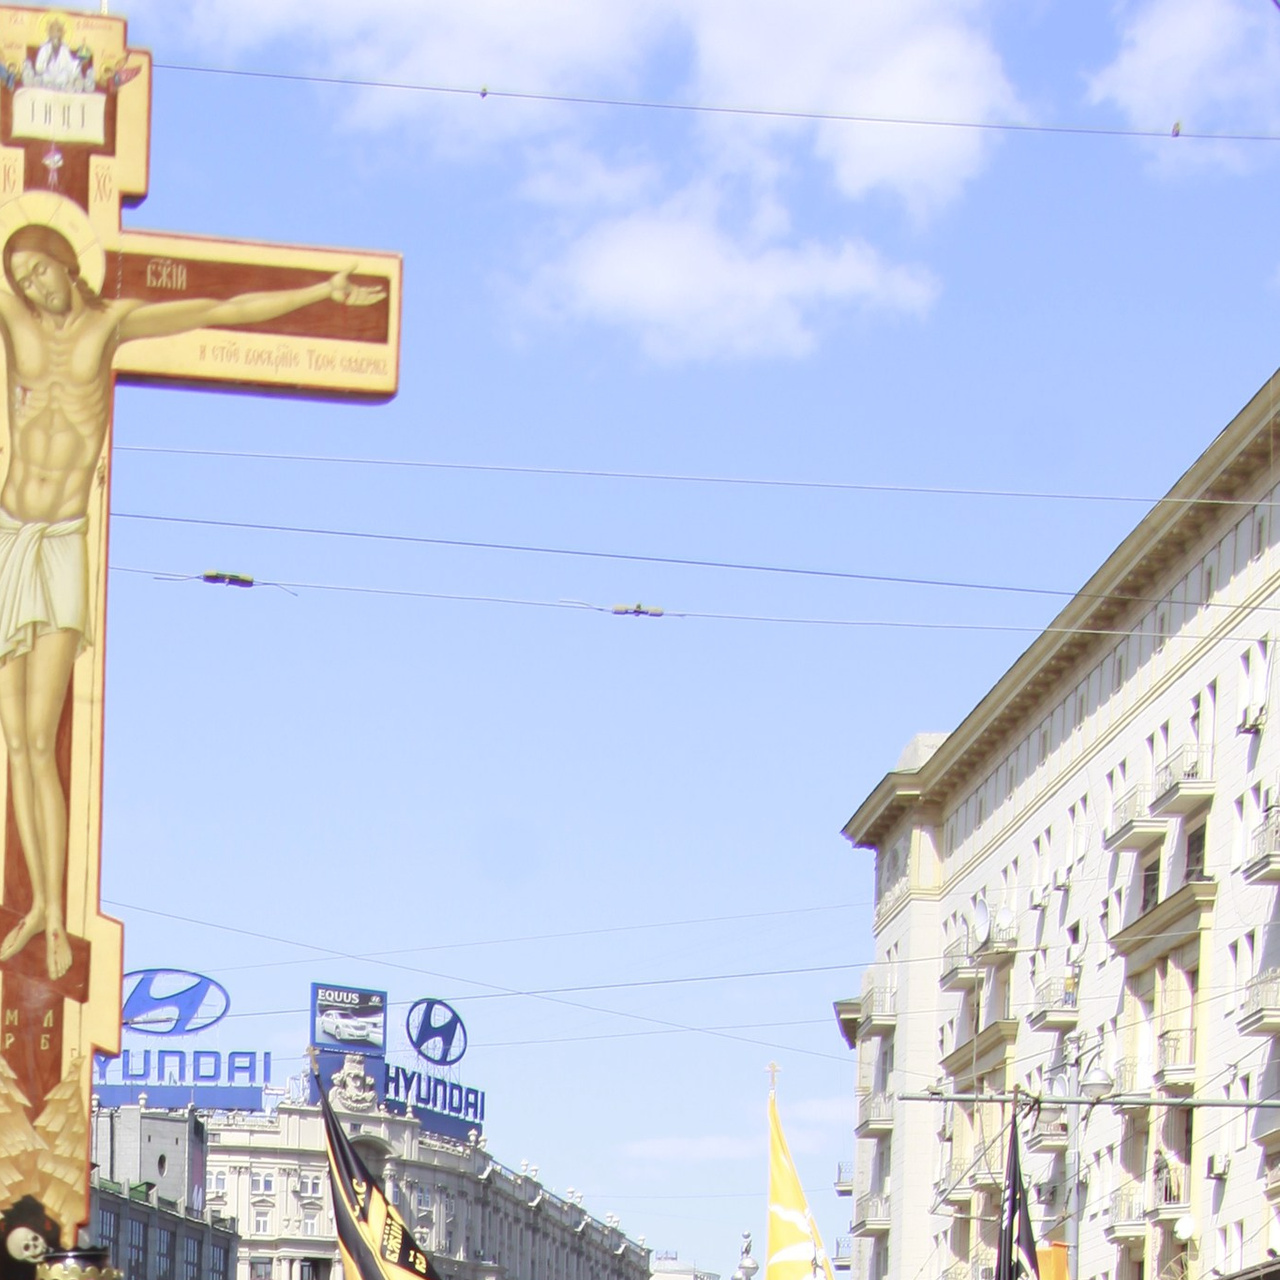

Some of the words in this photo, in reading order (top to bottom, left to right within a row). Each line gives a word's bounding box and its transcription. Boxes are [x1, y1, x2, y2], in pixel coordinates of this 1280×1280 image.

[318, 989, 360, 1004] EQUUS
[94, 1049, 272, 1083] YUNDAI
[384, 1062, 486, 1122] HYUNDAI
